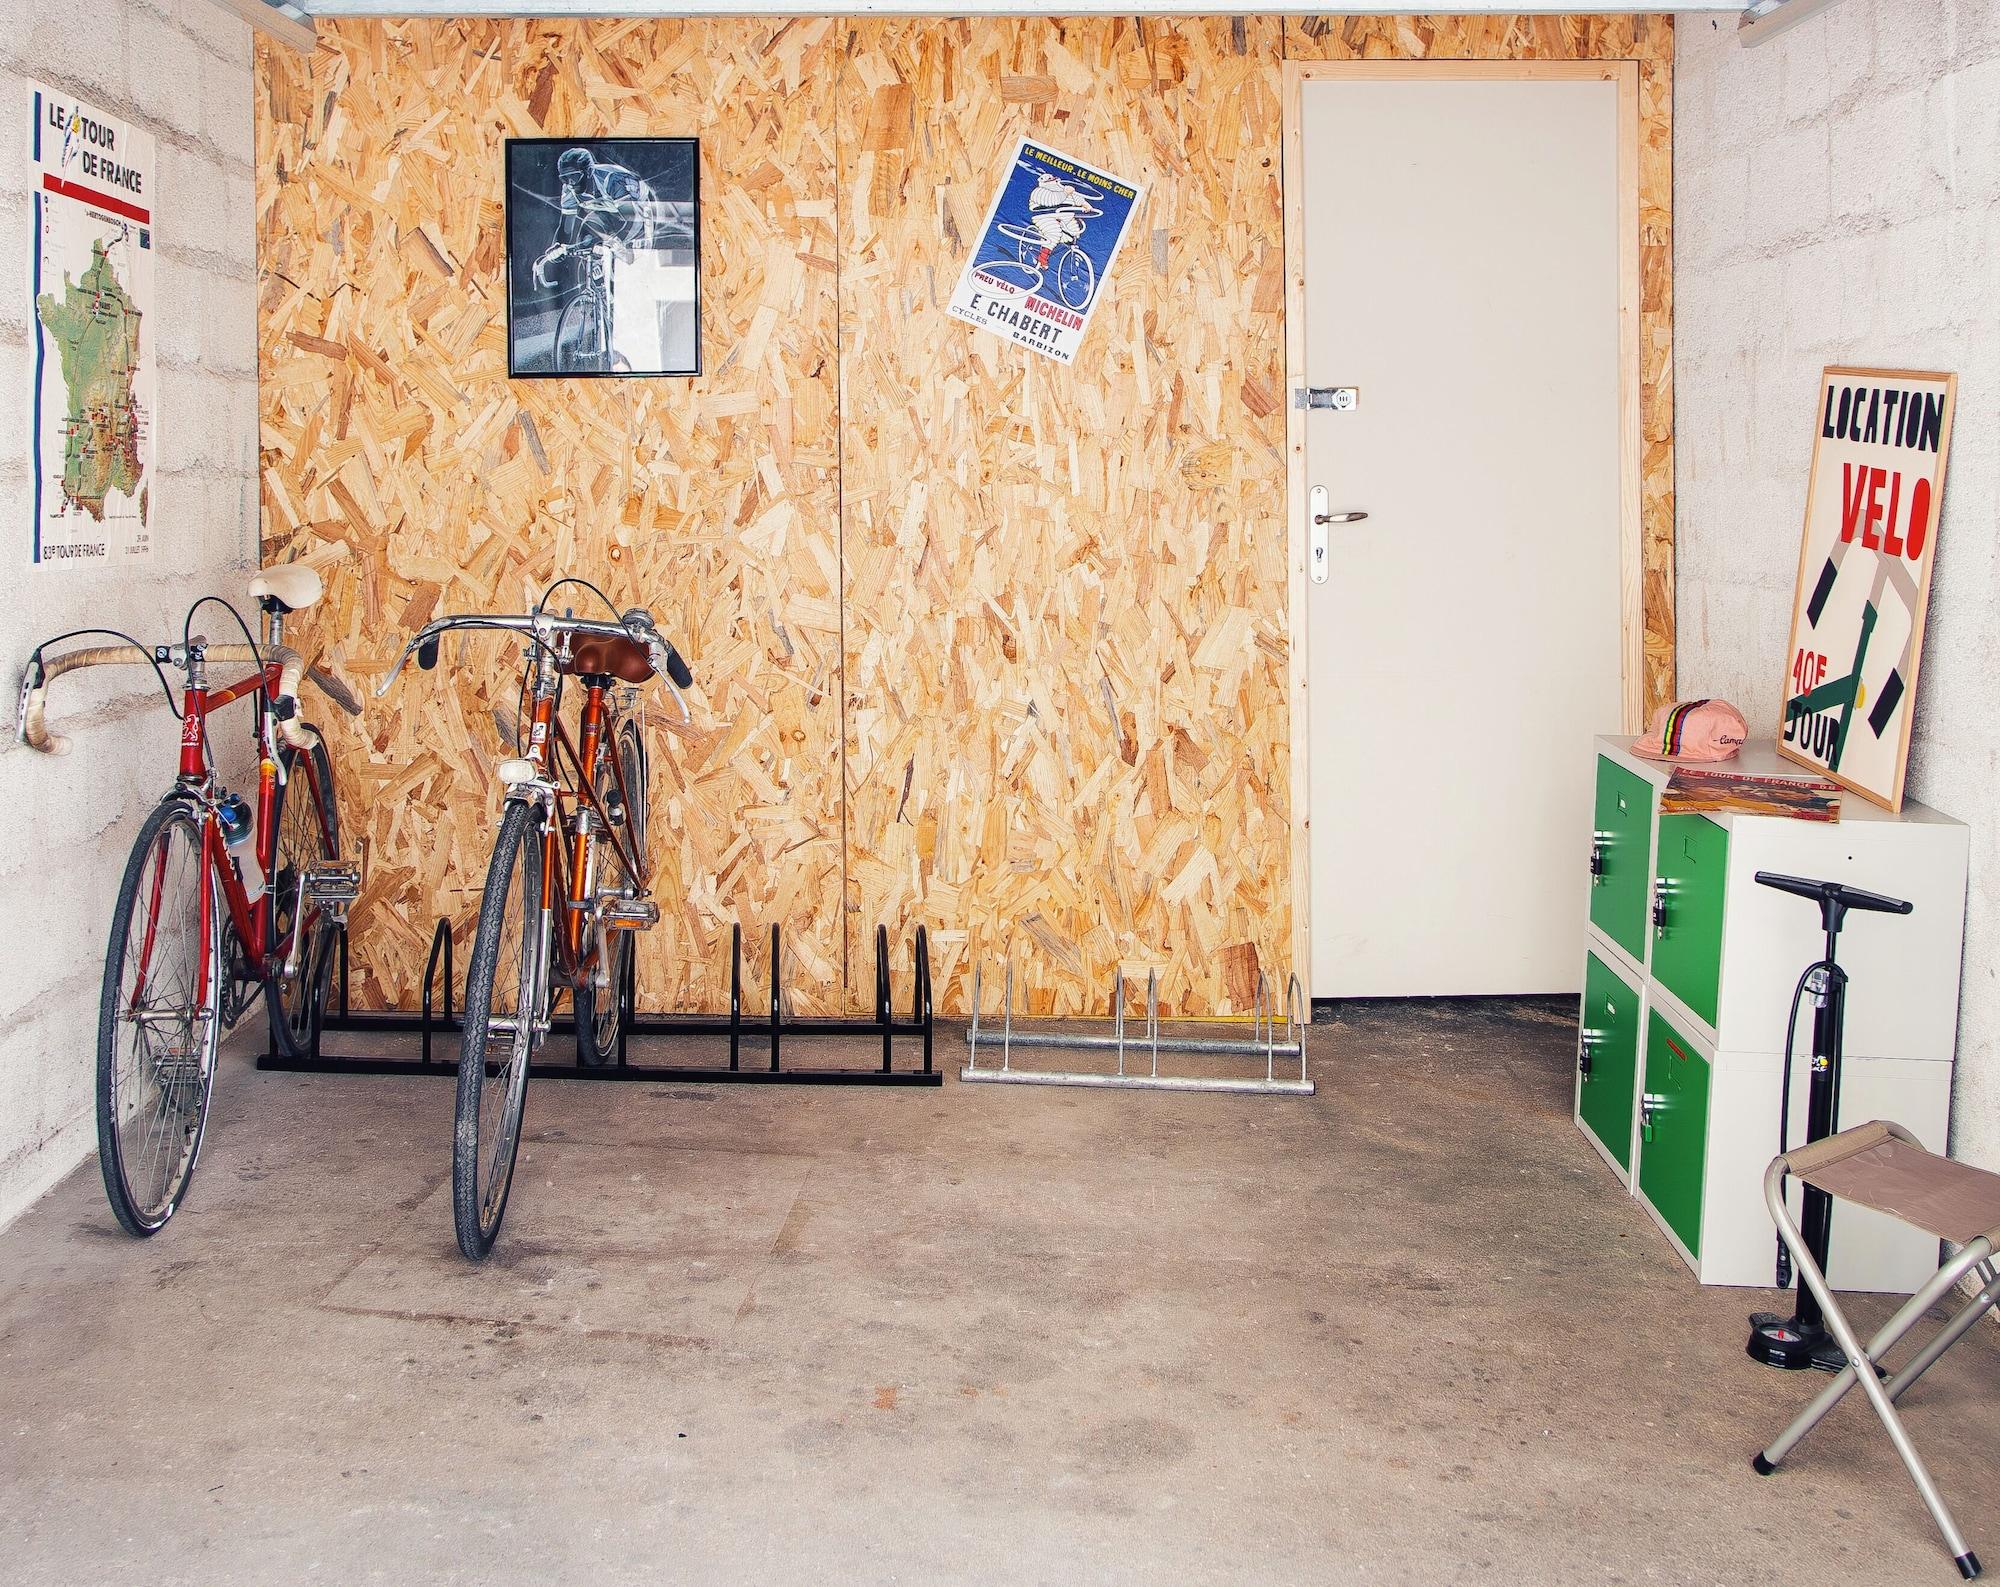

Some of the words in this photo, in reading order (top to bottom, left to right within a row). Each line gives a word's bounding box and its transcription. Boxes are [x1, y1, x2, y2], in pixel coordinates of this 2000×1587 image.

[50, 103, 65, 130] LE
[81, 117, 114, 151] TOUR
[83, 151, 97, 176] DE
[101, 158, 141, 194] FRANCE
[1025, 147, 1034, 157] LE
[1077, 169, 1086, 178] LE
[1088, 174, 1113, 190] MOINS
[1114, 186, 1135, 199] CHER
[996, 279, 1015, 294] VÉLO
[952, 306, 988, 325] CYCLES
[970, 294, 981, 311] E.
[987, 301, 1062, 343] CHABERT
[1025, 296, 1084, 331] MICHELIN
[1013, 332, 1069, 360] BARBIZON
[1822, 385, 1945, 452] LOCATION
[1841, 463, 1931, 561] VELO
[57, 545, 73, 558] TOUR
[74, 545, 81, 557] DE
[83, 544, 105, 557] FRANCE
[1784, 699, 1840, 766] JOUR
[1704, 771, 1735, 779] TOUR
[1764, 777, 1811, 788] FRANCE
